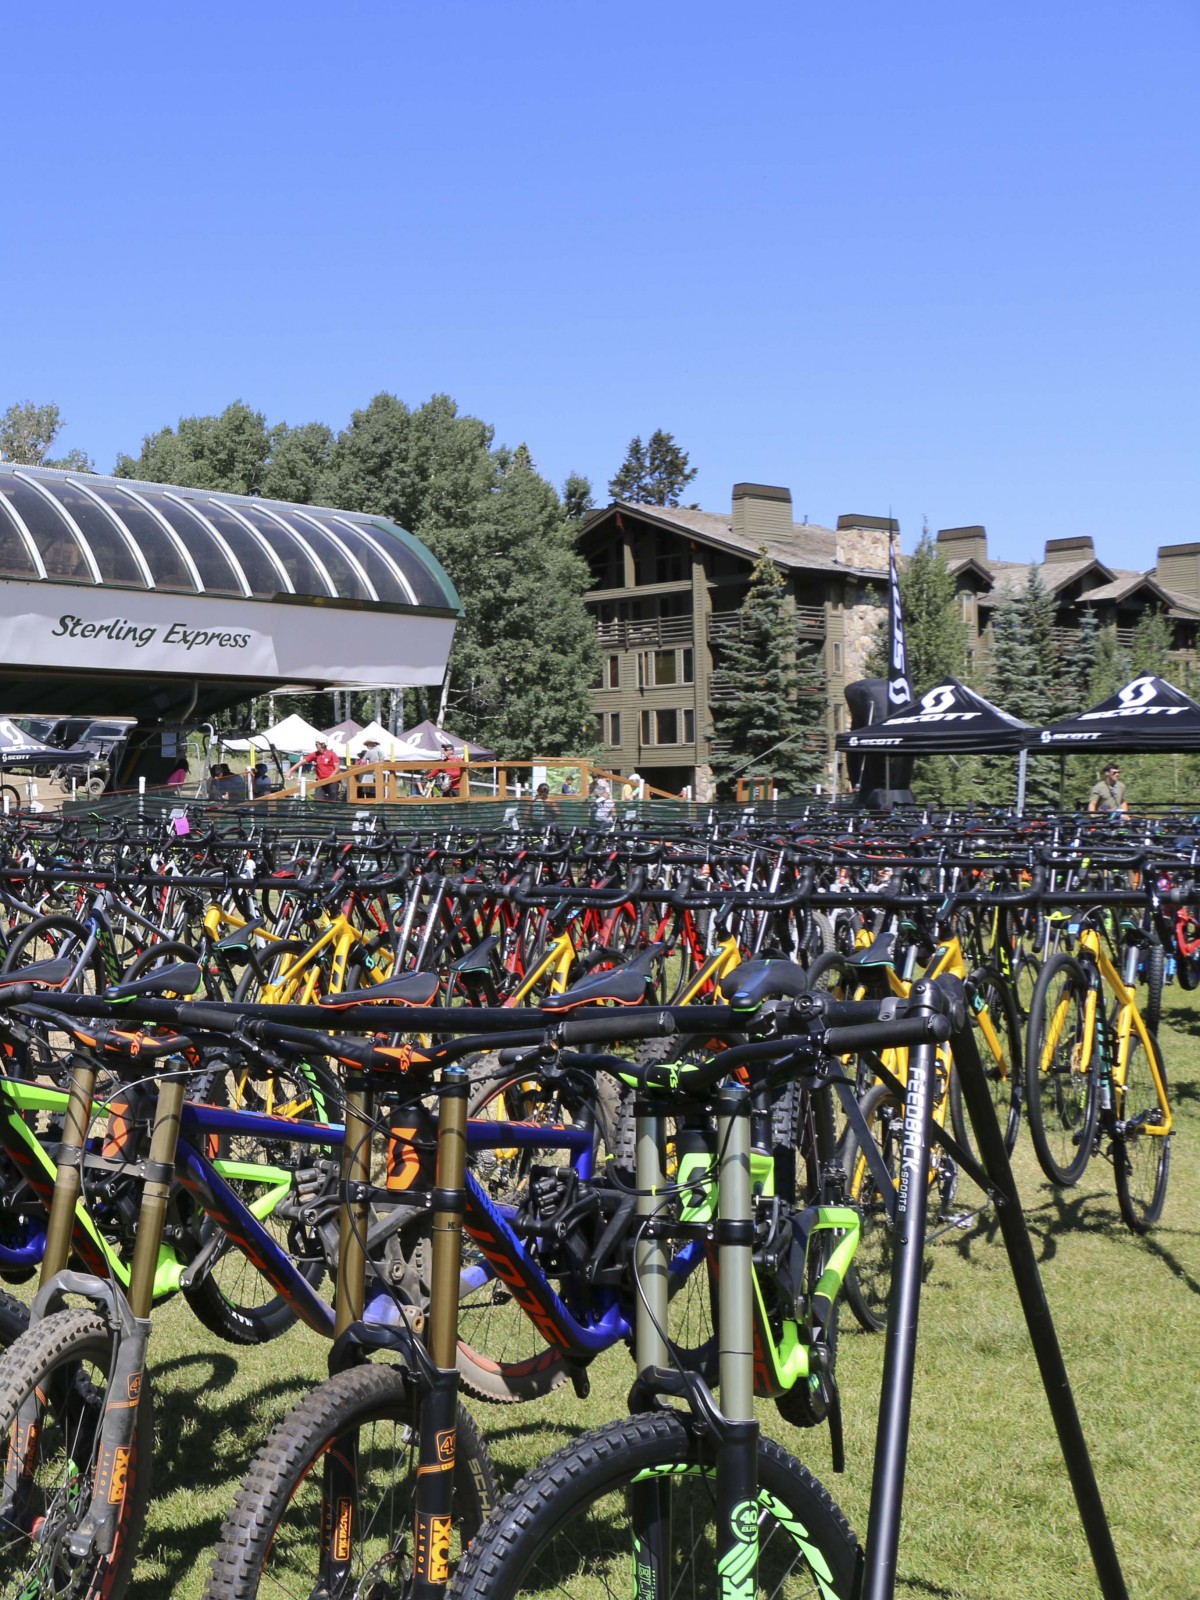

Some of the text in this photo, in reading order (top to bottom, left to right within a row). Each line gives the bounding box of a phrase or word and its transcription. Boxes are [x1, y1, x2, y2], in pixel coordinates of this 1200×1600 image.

[51, 614, 251, 650] Sterling Express
[882, 712, 982, 726] SCOTT
[1077, 706, 1190, 721] SCOTT
[1051, 732, 1102, 740] SCOTT
[898, 1067, 927, 1212] FEEDBACK SPORTS
[98, 1451, 111, 1496] FORTY
[739, 1509, 758, 1525] 40
[417, 1523, 427, 1574] FORTY
[430, 1519, 451, 1581] FOX
